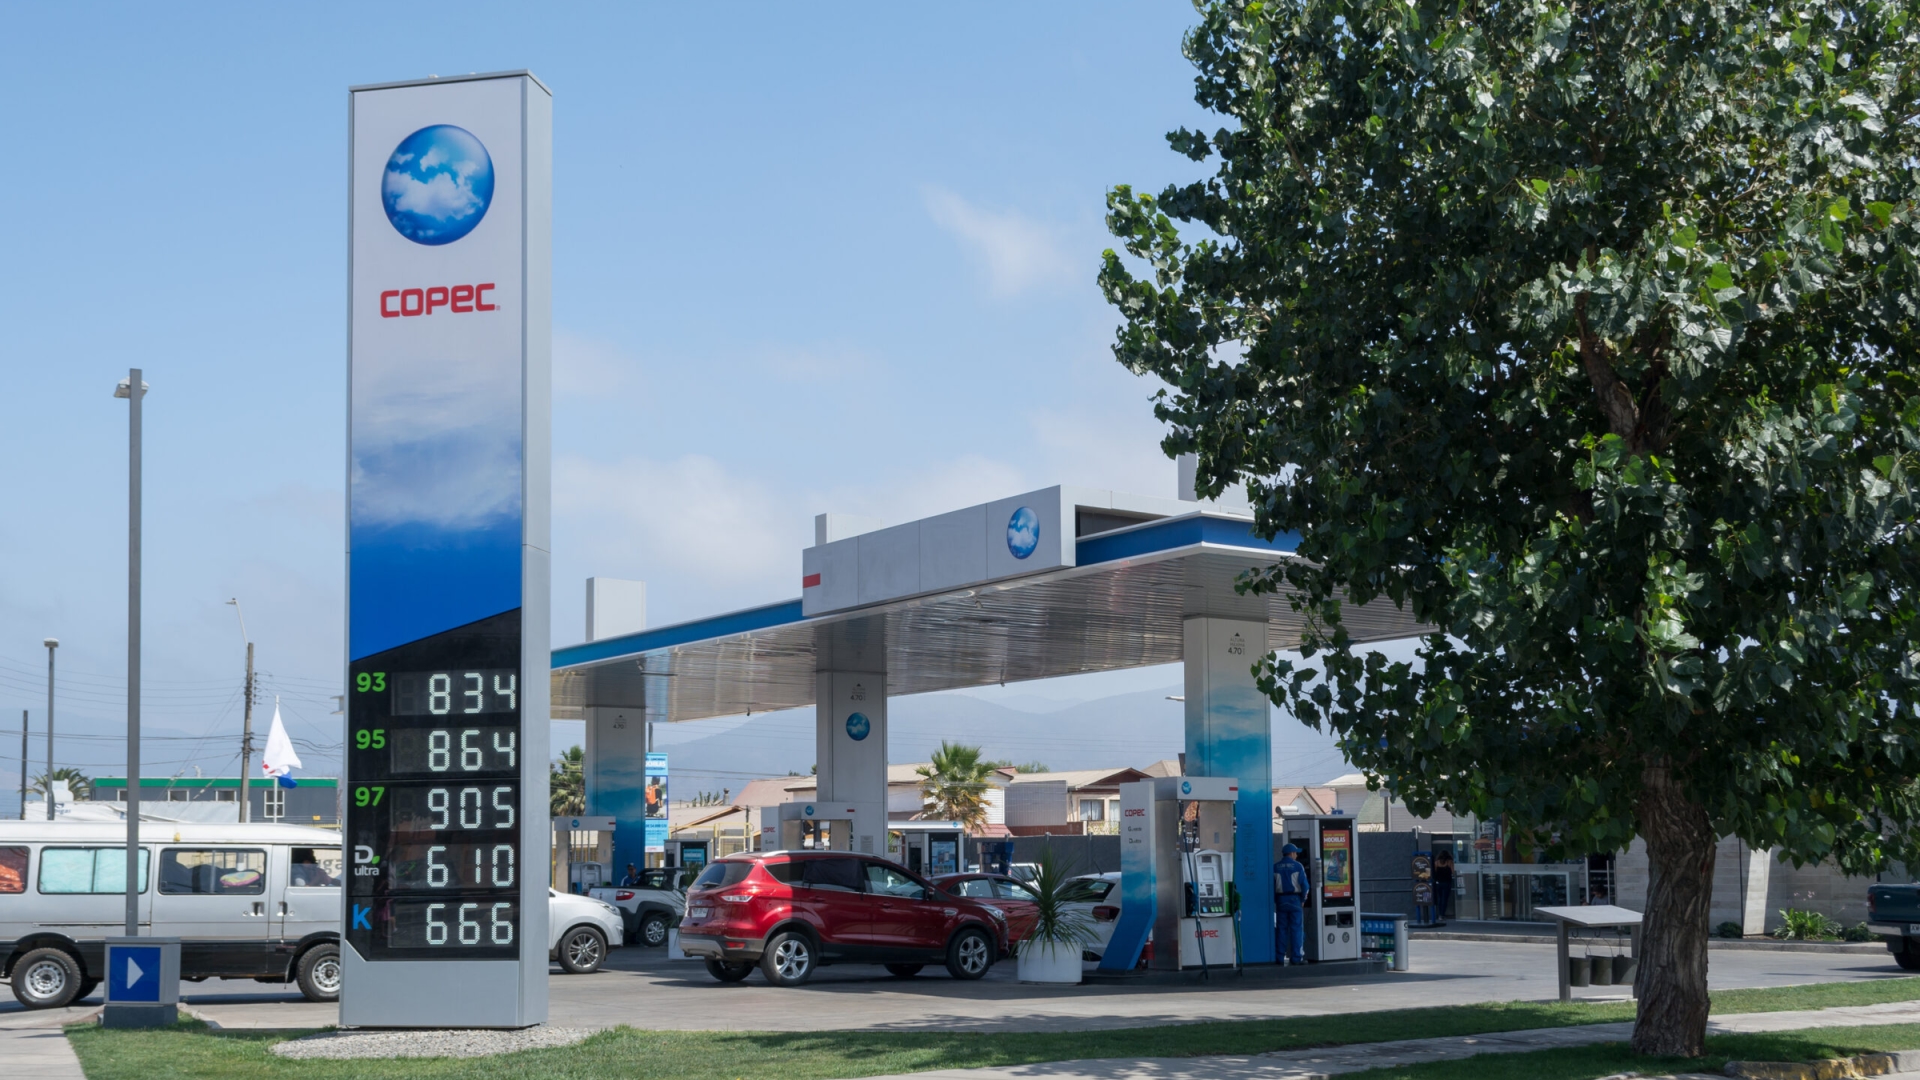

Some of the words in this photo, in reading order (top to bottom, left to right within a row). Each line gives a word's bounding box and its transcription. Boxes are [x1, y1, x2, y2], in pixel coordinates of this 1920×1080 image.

[380, 283, 495, 318] COPEC
[356, 672, 386, 692] 93
[429, 673, 516, 714] 834
[356, 730, 386, 750] 95
[428, 730, 515, 772] 864
[355, 787, 385, 807] 97
[427, 787, 515, 829] 905
[1124, 808, 1145, 817] COPEC
[354, 845, 374, 864] D
[427, 844, 514, 887] 610
[354, 865, 380, 876] ultra
[352, 903, 372, 929] K
[426, 902, 513, 945] 666
